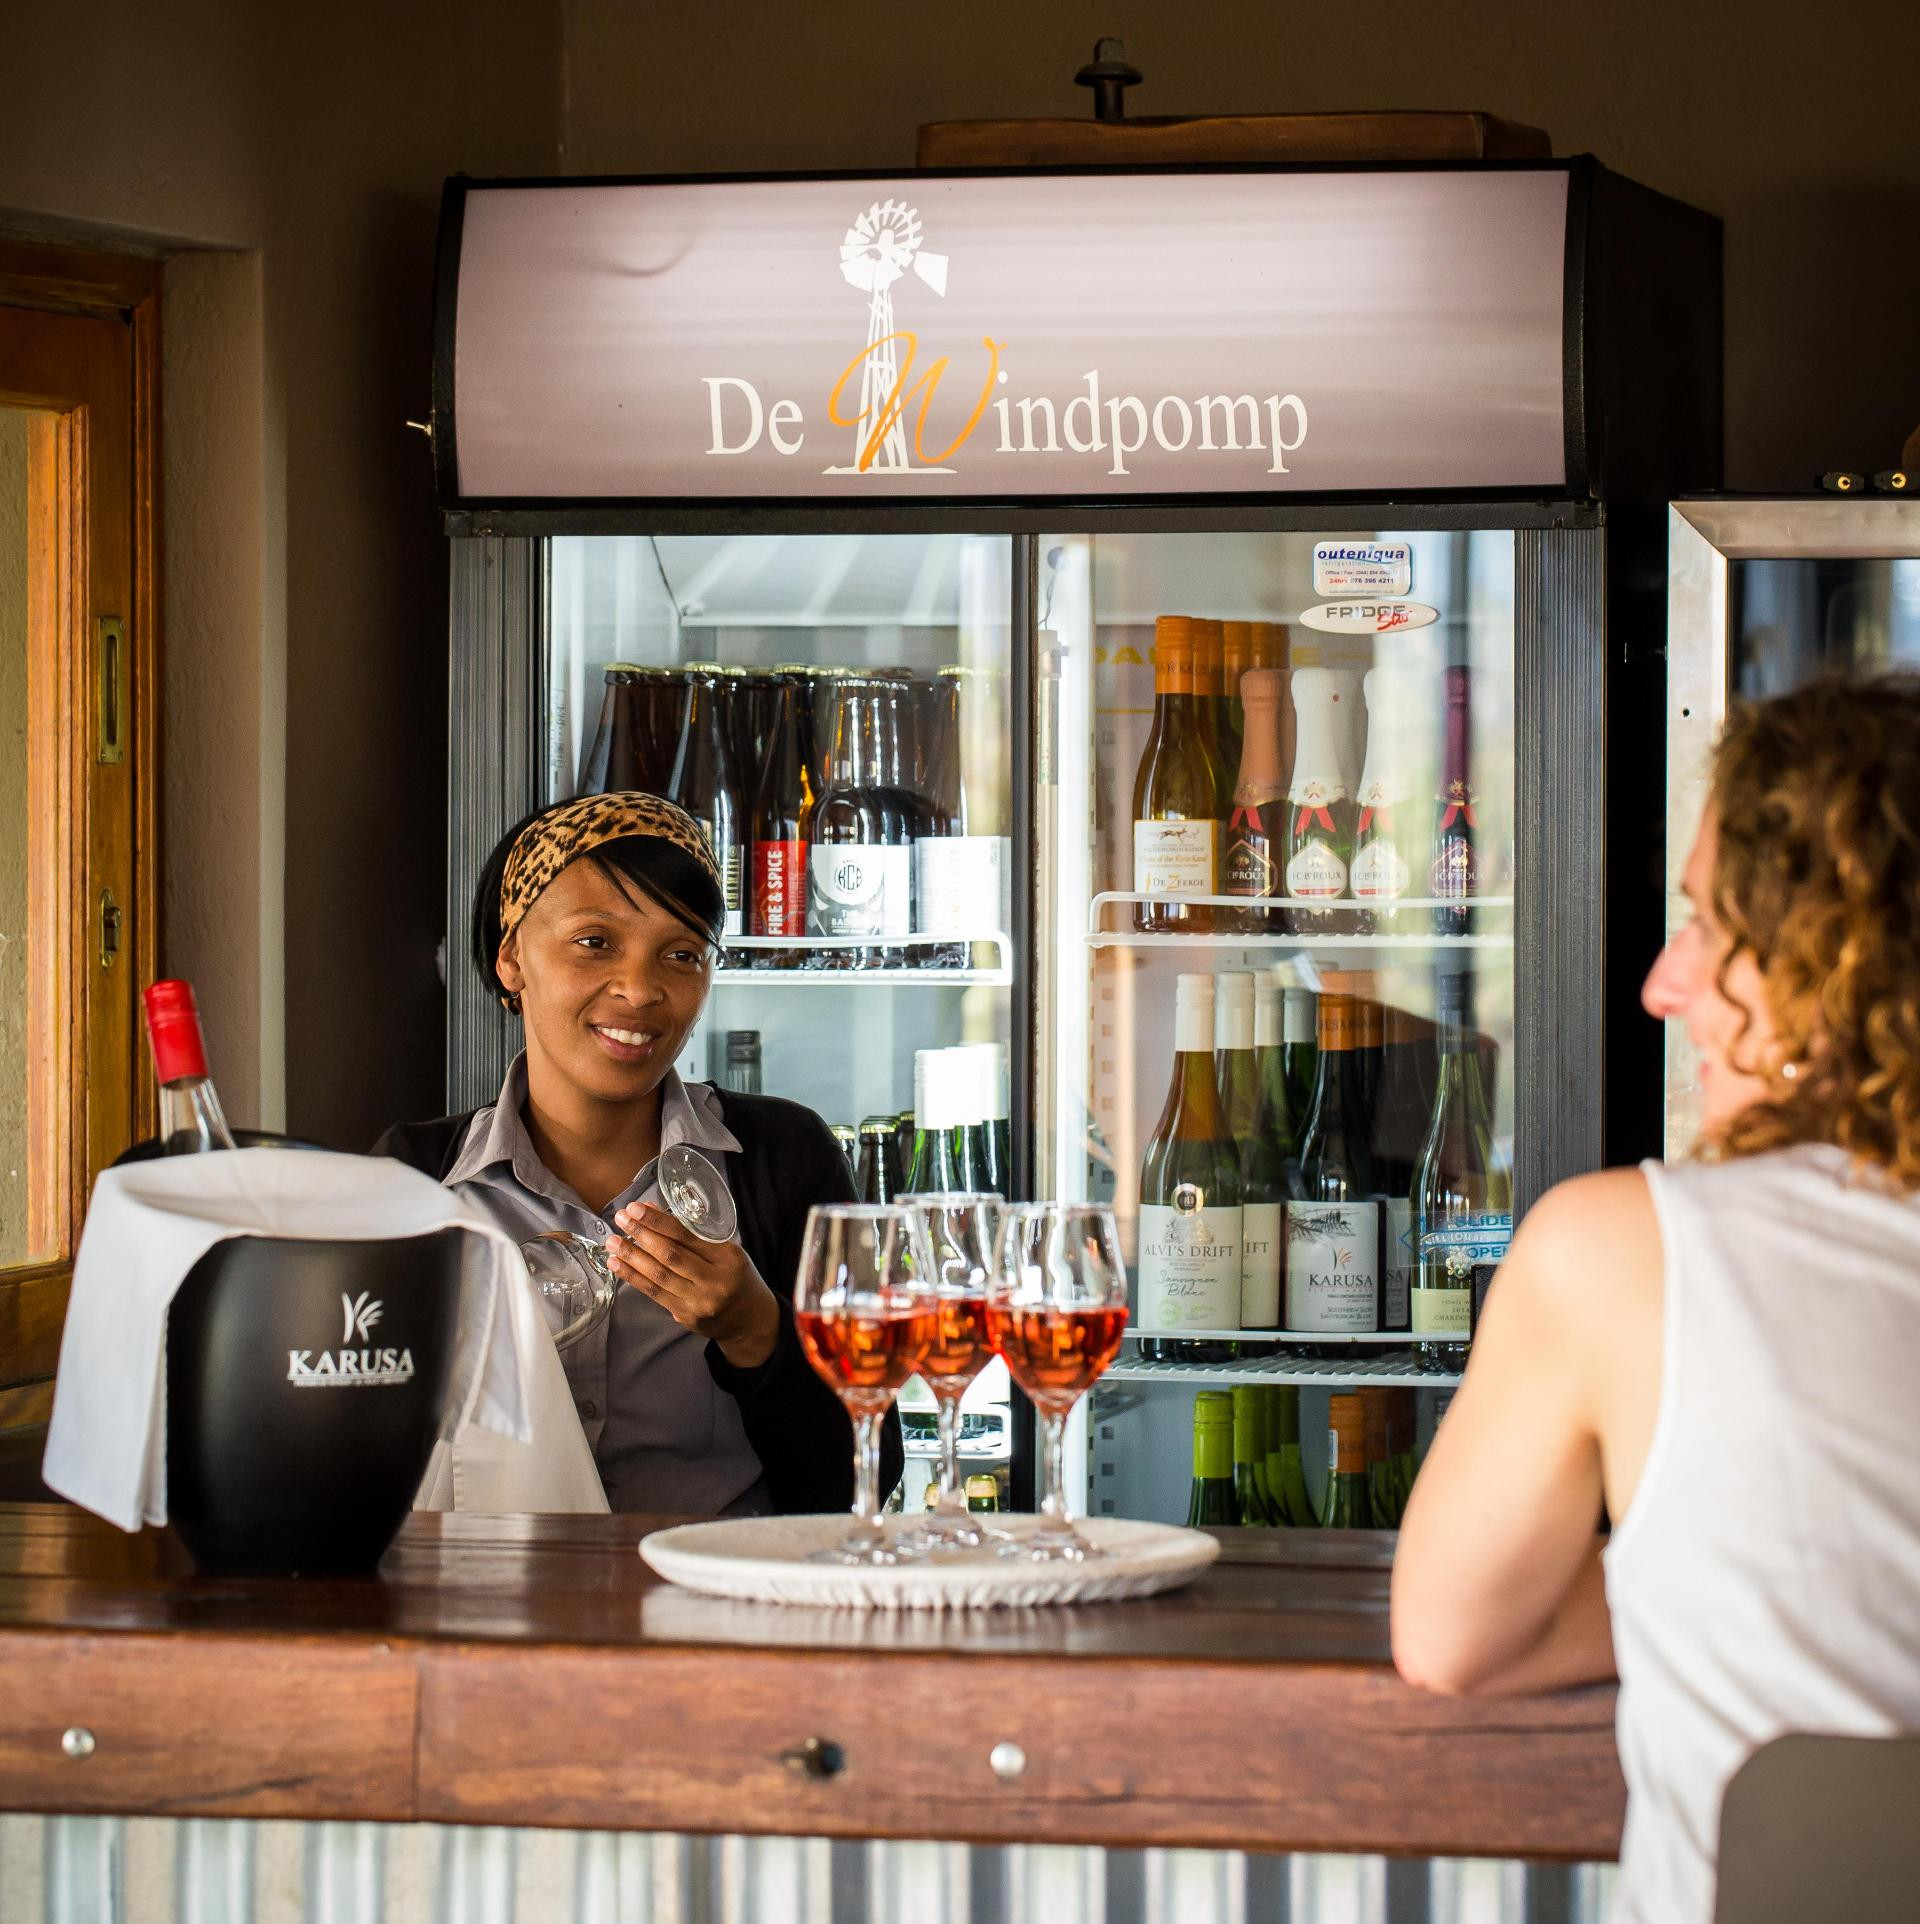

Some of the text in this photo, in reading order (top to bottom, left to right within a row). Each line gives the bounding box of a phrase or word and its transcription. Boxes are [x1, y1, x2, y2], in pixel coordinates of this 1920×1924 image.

[701, 331, 1309, 476] De Windpomp
[1317, 548, 1405, 562] outeniqua
[767, 850, 784, 935] FIRE & SPICE
[1144, 1244, 1235, 1257] ALVI'S DRIFT
[1309, 1273, 1373, 1287] KARUSA
[287, 1348, 415, 1375] KARUSA
